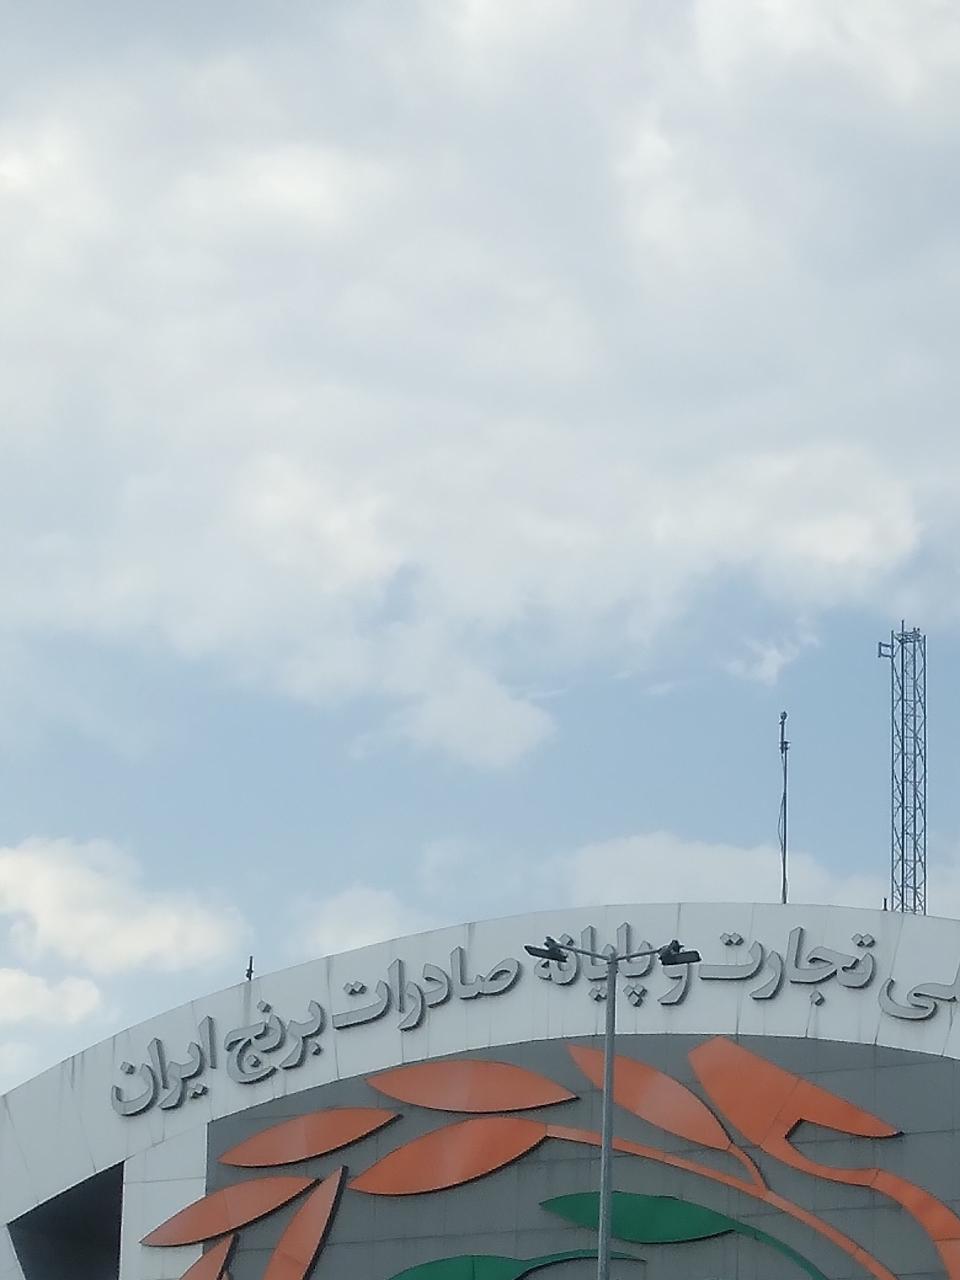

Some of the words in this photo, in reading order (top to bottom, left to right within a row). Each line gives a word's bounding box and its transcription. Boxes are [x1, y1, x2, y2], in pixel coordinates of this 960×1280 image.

[331, 944, 522, 1032] صادرات
[699, 925, 878, 1006] تجارت
[109, 1014, 218, 1118] ایران
[223, 998, 327, 1085] برنج
